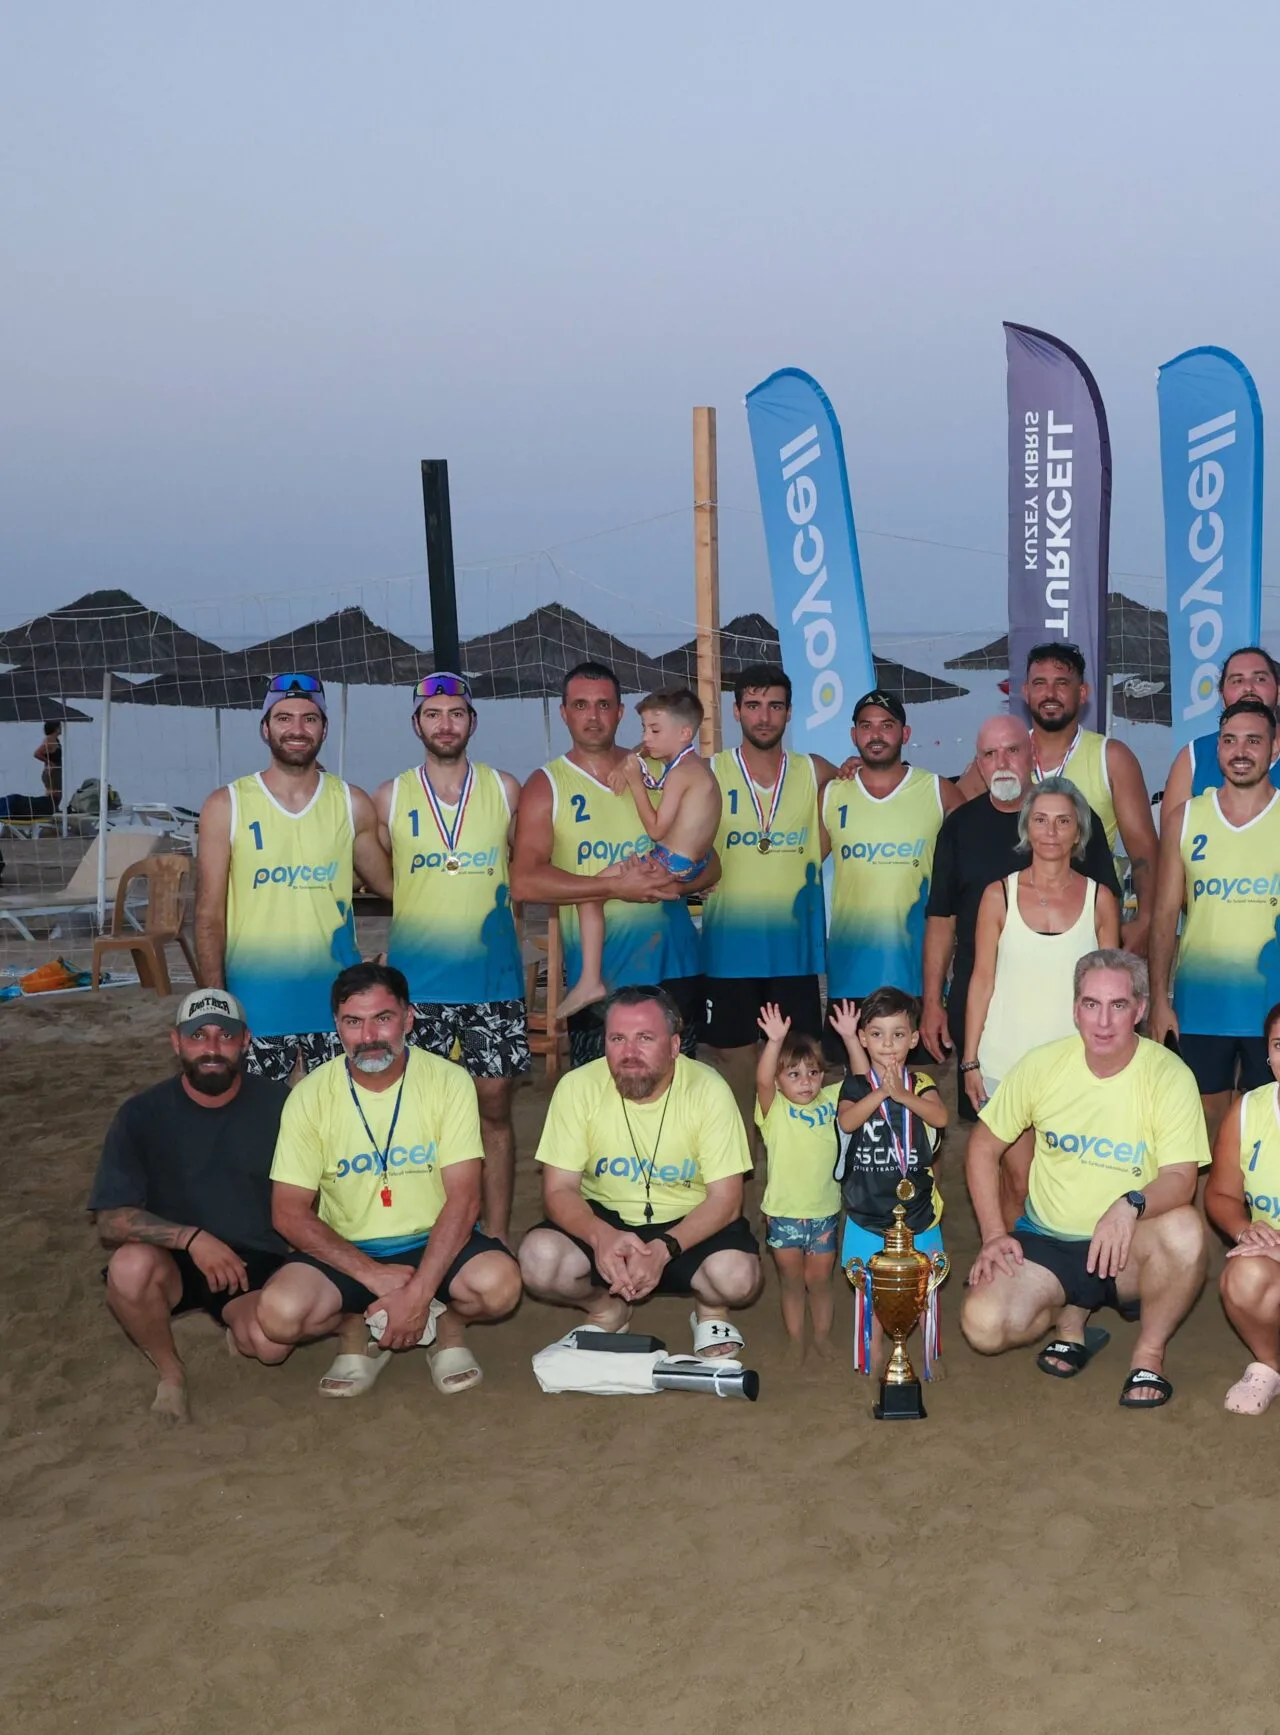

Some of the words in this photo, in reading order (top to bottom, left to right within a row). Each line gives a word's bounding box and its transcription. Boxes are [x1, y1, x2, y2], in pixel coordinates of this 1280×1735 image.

[570, 794, 591, 823] 2
[727, 789, 738, 814] 1
[408, 809, 419, 837] 1
[838, 804, 848, 829] 1
[248, 821, 263, 850] 1
[1191, 834, 1208, 861] 2
[841, 839, 926, 863] paycell
[1248, 1140, 1261, 1172] 1
